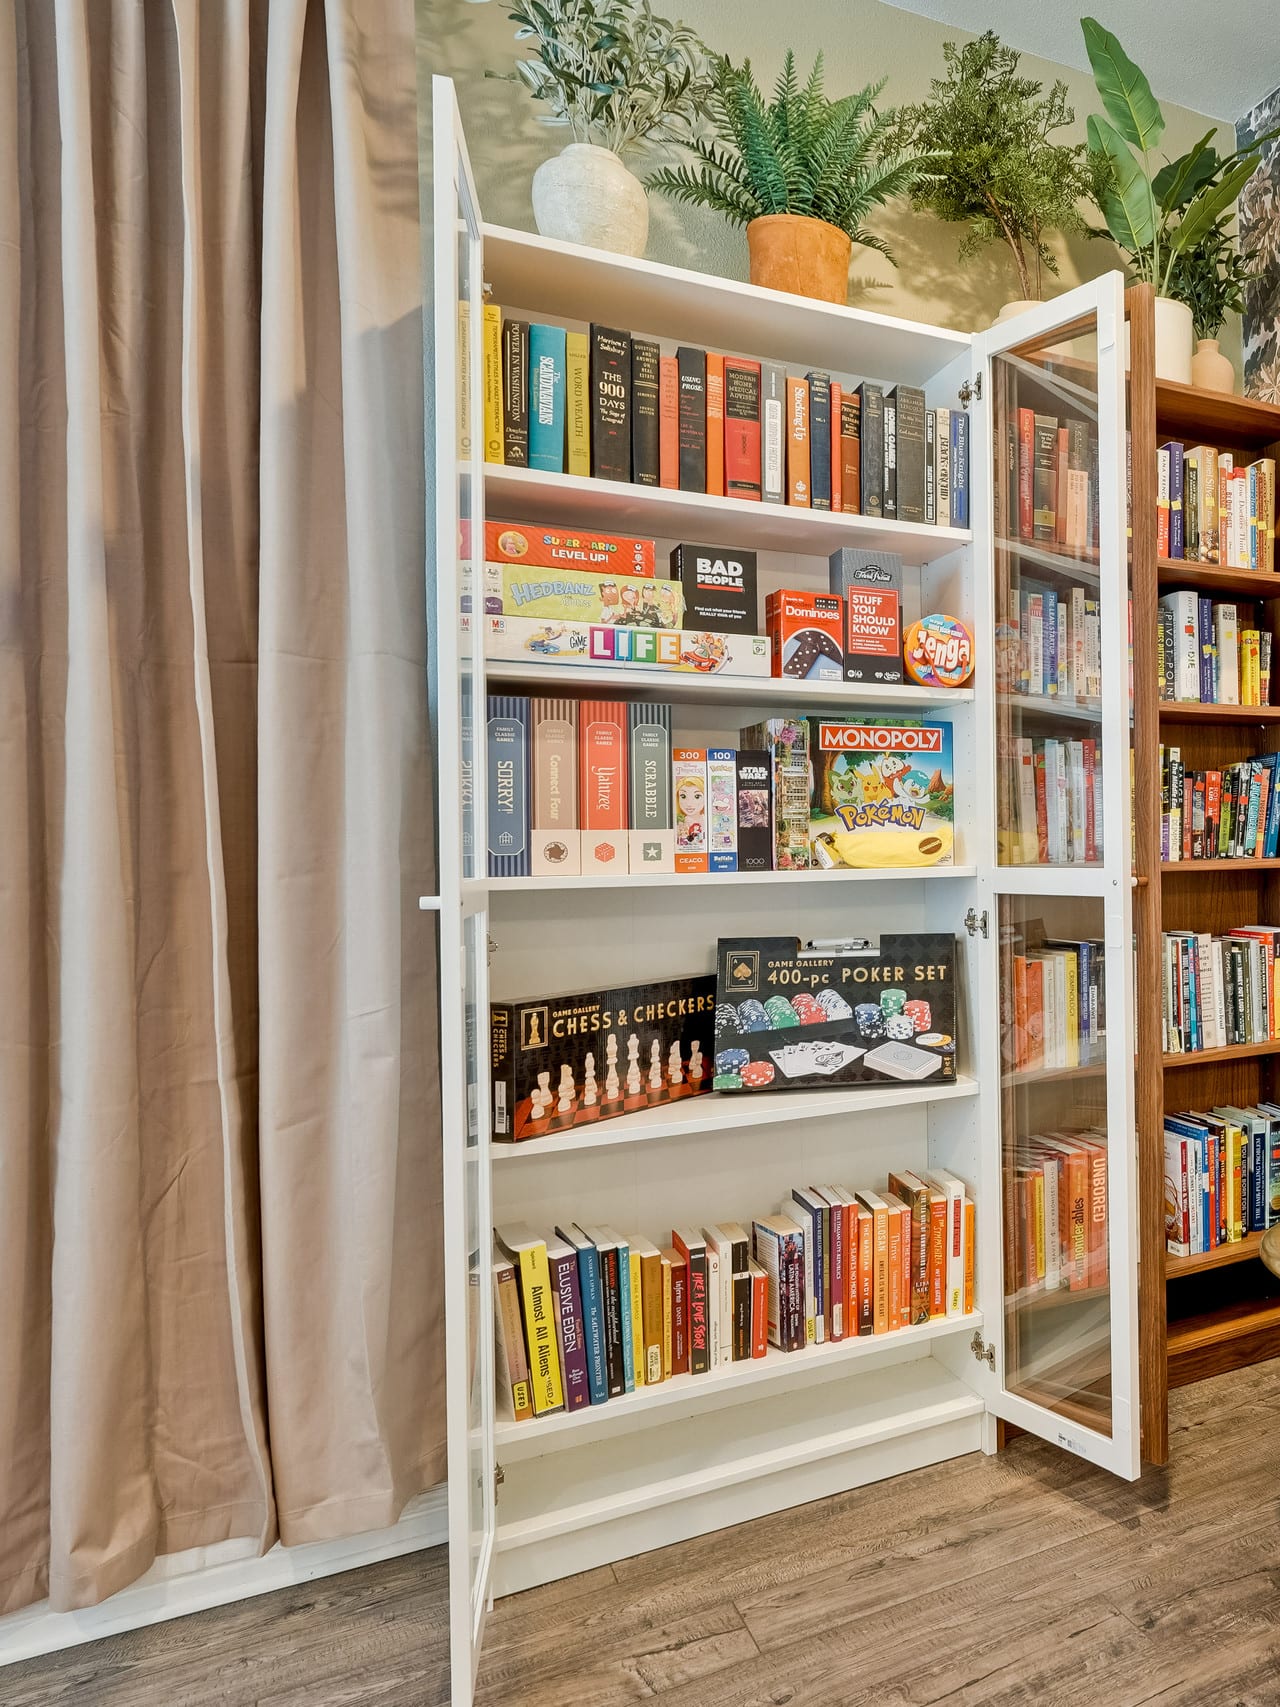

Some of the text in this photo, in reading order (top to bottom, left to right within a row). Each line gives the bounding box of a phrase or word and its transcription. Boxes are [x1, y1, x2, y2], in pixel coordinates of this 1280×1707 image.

[597, 335, 623, 347] Harrison
[600, 344, 624, 356] Salisbury
[636, 356, 657, 364] ANSWERS
[511, 324, 520, 422] POWER IN WASHINGTON
[574, 367, 582, 397] WORD
[602, 371, 622, 383] THE
[729, 372, 756, 382] MODERN
[539, 356, 554, 425] SCANDINAVIANS
[599, 382, 624, 398] 900
[729, 386, 757, 395] MEDICAL
[734, 380, 753, 388] HOME
[600, 398, 625, 409] DAYS
[730, 393, 756, 402] ADVISER
[575, 400, 583, 437] WEALTH
[793, 387, 807, 440] Stocking Up
[1206, 449, 1214, 499] Daniel Silva
[543, 536, 617, 552] SUPER MARIO
[552, 549, 608, 563] LEVEL UP!
[697, 558, 743, 576] BAD
[697, 575, 743, 586] PEOPLE
[510, 582, 596, 606] HEDBANZ
[853, 595, 882, 605] STUFF
[786, 606, 840, 620] Dominoes
[853, 606, 875, 614] YOU
[853, 616, 895, 626] SHOULD
[853, 625, 888, 635] KNOW
[570, 635, 587, 648] GAME
[591, 627, 680, 664] LIFE
[913, 631, 970, 670] Jenga
[824, 729, 938, 748] MONOPOLY
[497, 760, 513, 814] SORRY!
[550, 754, 560, 820] Connect Four
[592, 766, 616, 811] Yahtzee
[645, 760, 656, 818] SCRABBLE
[768, 966, 946, 988] 400-pc POKER SET
[553, 995, 714, 1038] CHESS & CHECKERS
[573, 1005, 600, 1015] GALLERY
[1093, 1158, 1106, 1222] UNBORED
[878, 1214, 886, 1252] BULOSAN
[933, 1226, 942, 1265] SYMPATHIZER
[692, 1272, 704, 1290] LIKE
[851, 1270, 856, 1280] NO
[673, 1280, 683, 1303] Inferno
[558, 1263, 576, 1353] ELUSIVE EDEN
[692, 1302, 705, 1323] LOVE
[531, 1286, 550, 1377] Almost All Aliens
[693, 1324, 706, 1350] STORY
[517, 1386, 525, 1407] USED
